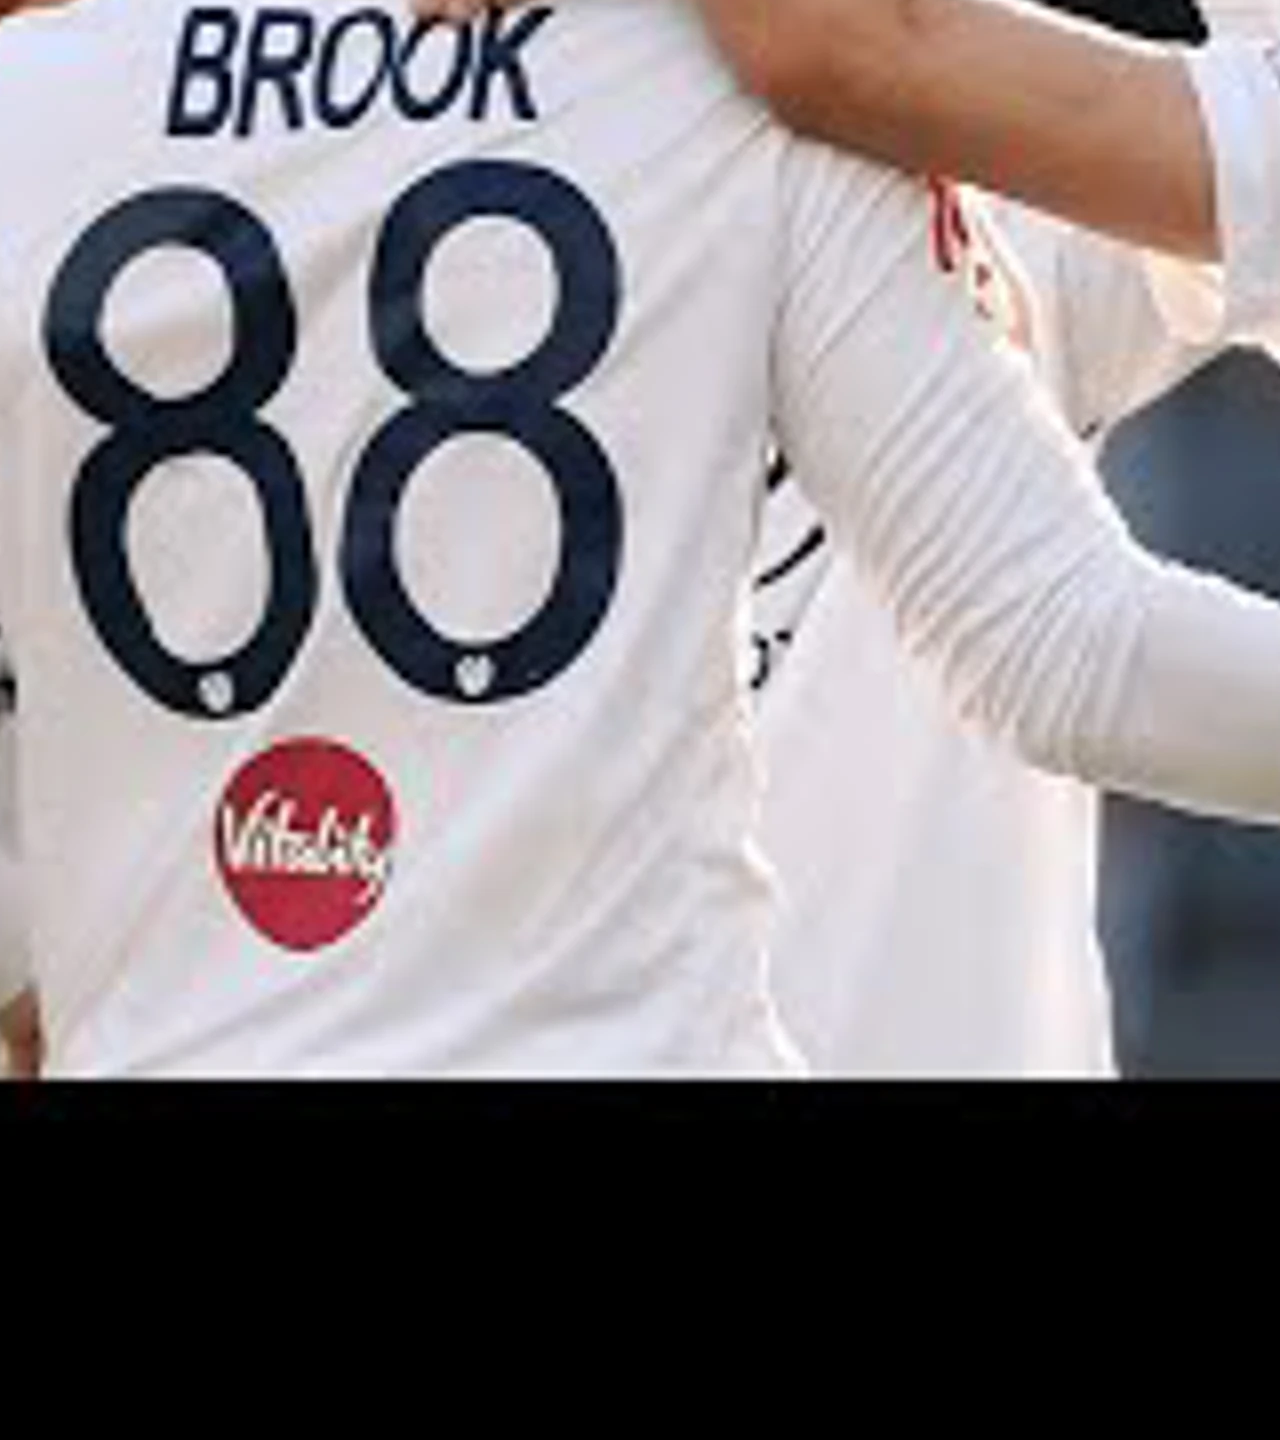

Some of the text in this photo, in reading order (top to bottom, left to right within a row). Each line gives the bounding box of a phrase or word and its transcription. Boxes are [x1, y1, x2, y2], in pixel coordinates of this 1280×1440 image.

[165, 5, 554, 138] BROOK
[42, 158, 624, 719] 88
[221, 790, 389, 906] Vitality
